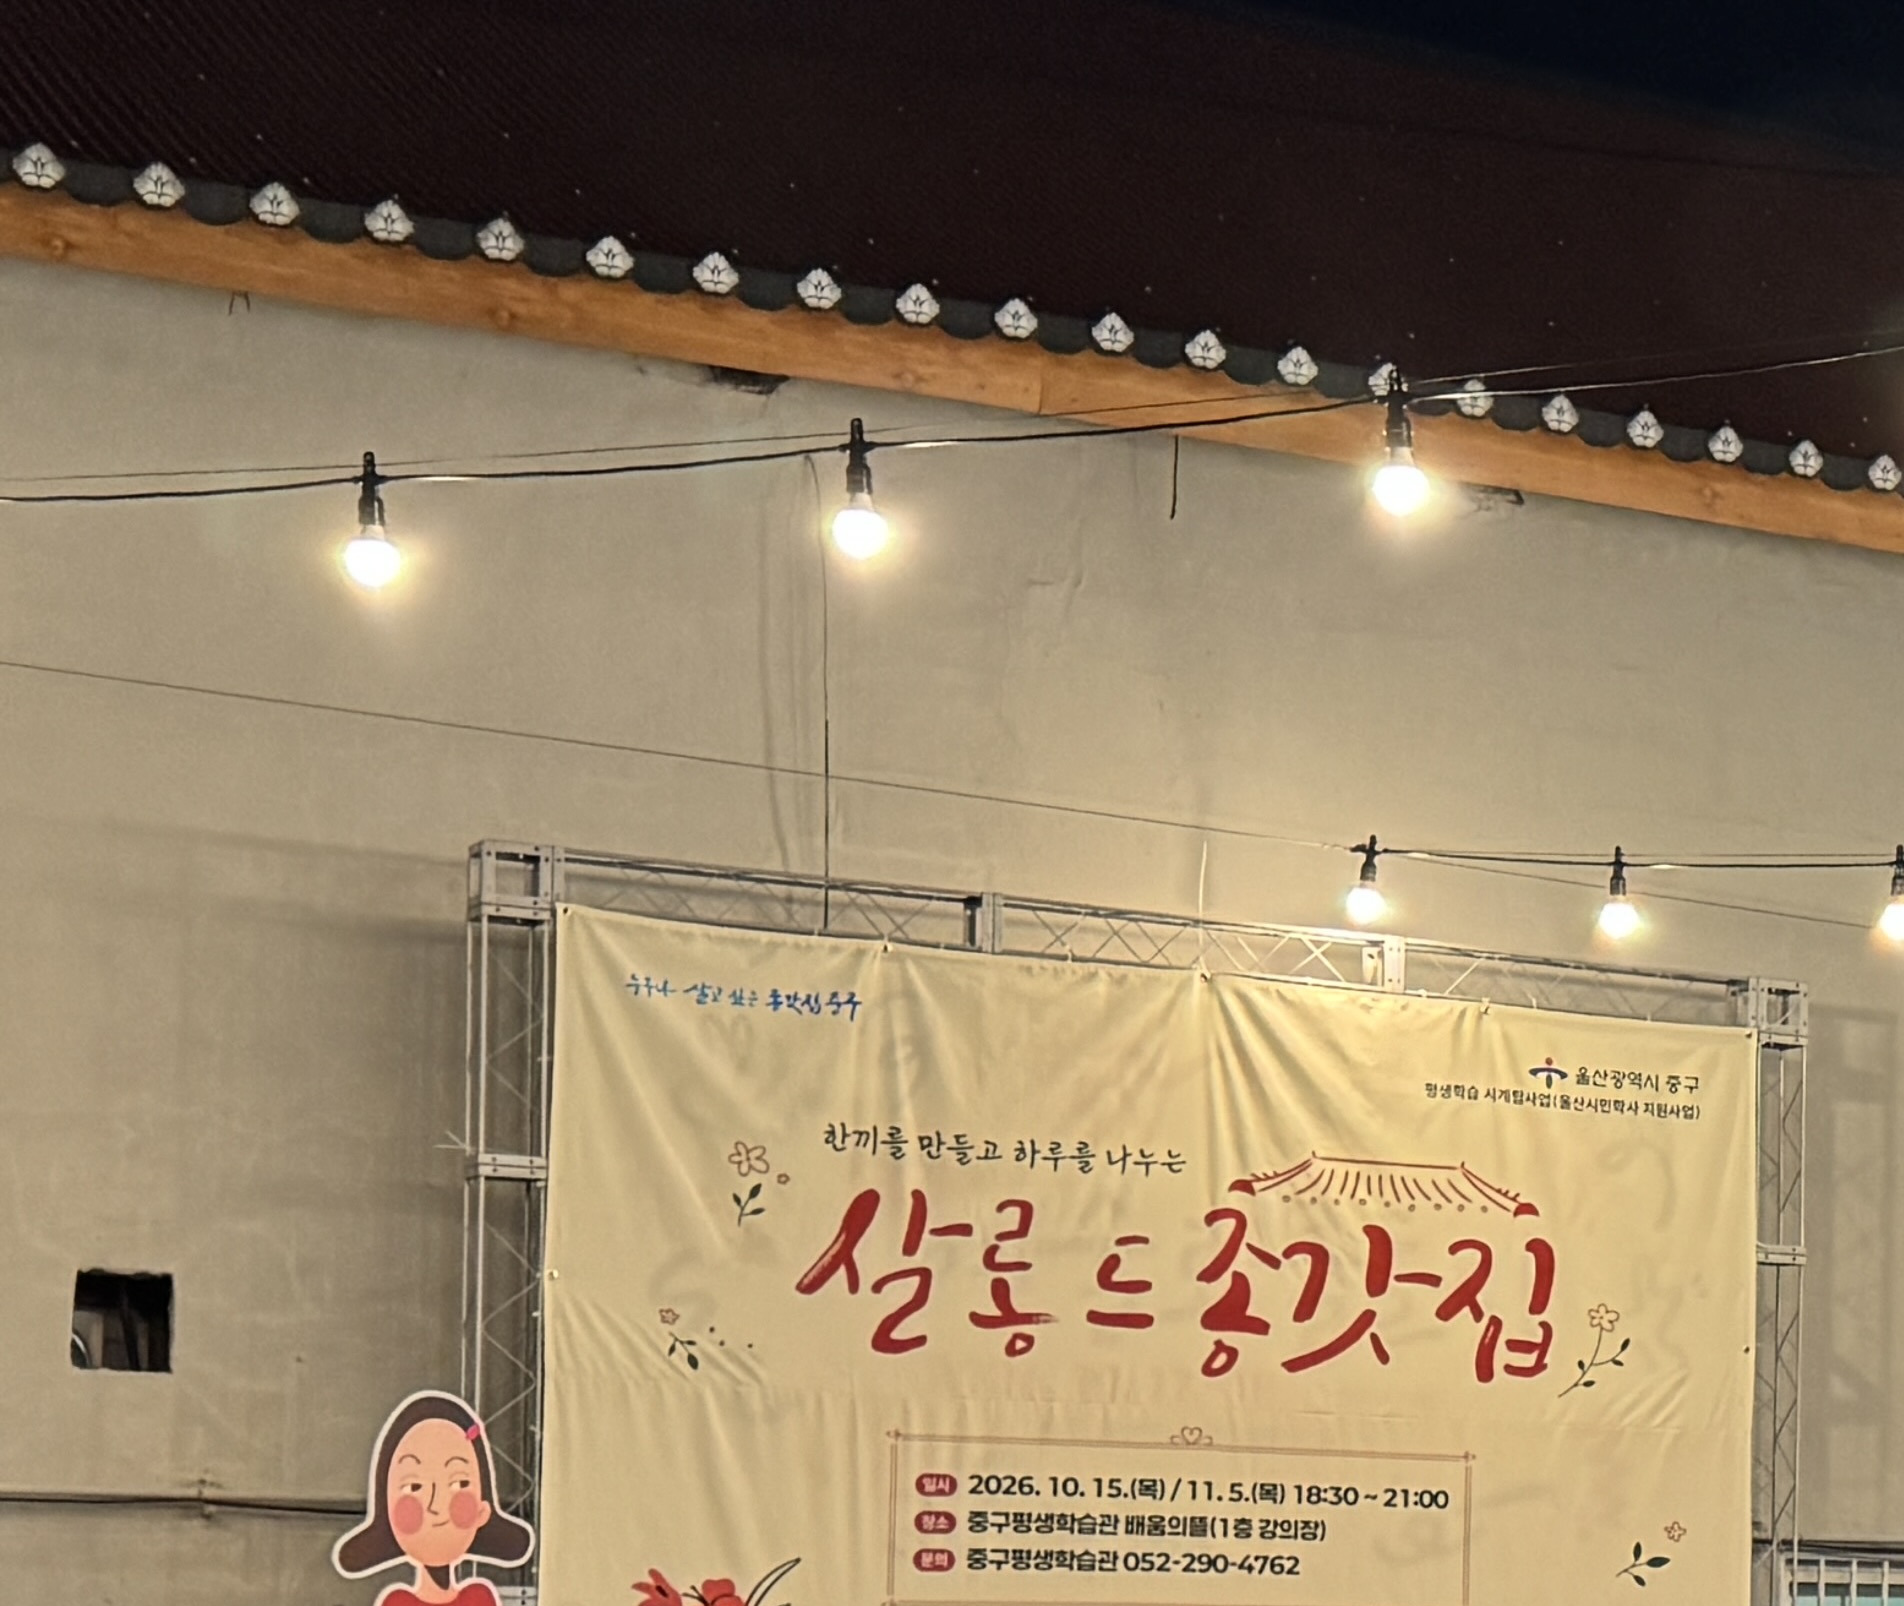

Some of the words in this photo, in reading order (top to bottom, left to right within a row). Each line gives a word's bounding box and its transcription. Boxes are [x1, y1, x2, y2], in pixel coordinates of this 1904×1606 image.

[1575, 1066, 1660, 1093] 울산광역시
[1665, 1074, 1700, 1095] 중구
[1425, 1082, 1479, 1101] 평생학습
[1642, 1101, 1701, 1121] 지원사업)
[823, 1122, 909, 1161] 한끼를
[918, 1130, 1002, 1166] 만들고
[1013, 1138, 1096, 1175] 하루를
[1106, 1143, 1188, 1178] 나누는
[796, 1188, 1060, 1358] 살롱
[1086, 1234, 1156, 1330] 드
[1196, 1207, 1556, 1384] 종갓집
[921, 1476, 950, 1494] 일시
[968, 1474, 1041, 1497] 2026.
[1049, 1476, 1085, 1498] 10.
[1092, 1477, 1165, 1501] 15.(목)
[1187, 1480, 1223, 1501] 11.
[1228, 1481, 1286, 1505] 5.(목)
[1294, 1484, 1360, 1506] 18:30
[1383, 1487, 1449, 1510] 21:00
[920, 1514, 949, 1531] 장소
[967, 1510, 1120, 1536] 중구평생학습관
[1258, 1518, 1326, 1542] 강의장)
[920, 1551, 948, 1569] 문의
[966, 1547, 1119, 1573] 중구평생학습관
[1123, 1551, 1300, 1576] 052-290-4762
